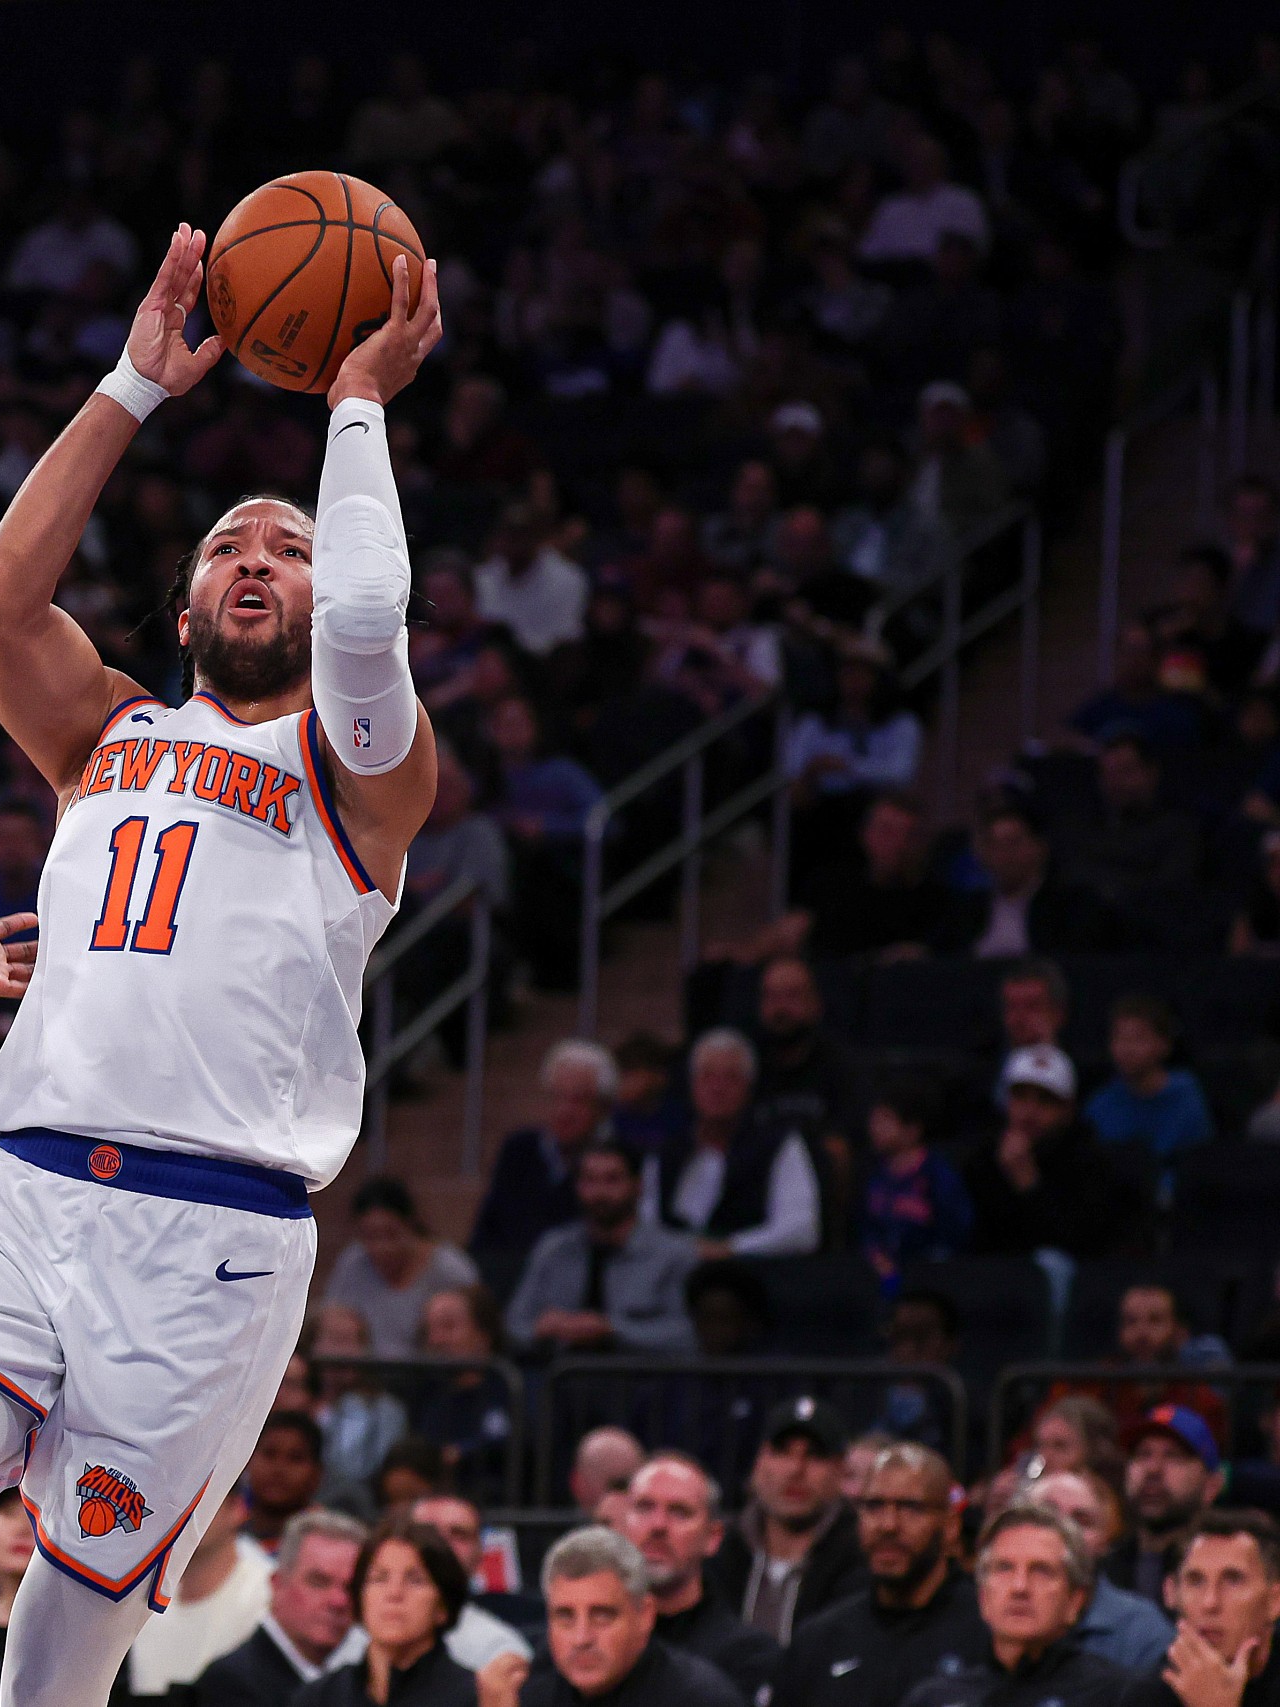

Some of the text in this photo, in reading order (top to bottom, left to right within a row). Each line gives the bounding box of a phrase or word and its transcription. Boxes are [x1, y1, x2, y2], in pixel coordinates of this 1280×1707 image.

[166, 741, 304, 838] YORK
[88, 815, 200, 956] 11
[77, 1465, 145, 1530] KNICKS
[107, 1467, 137, 1492] NEW YORK
